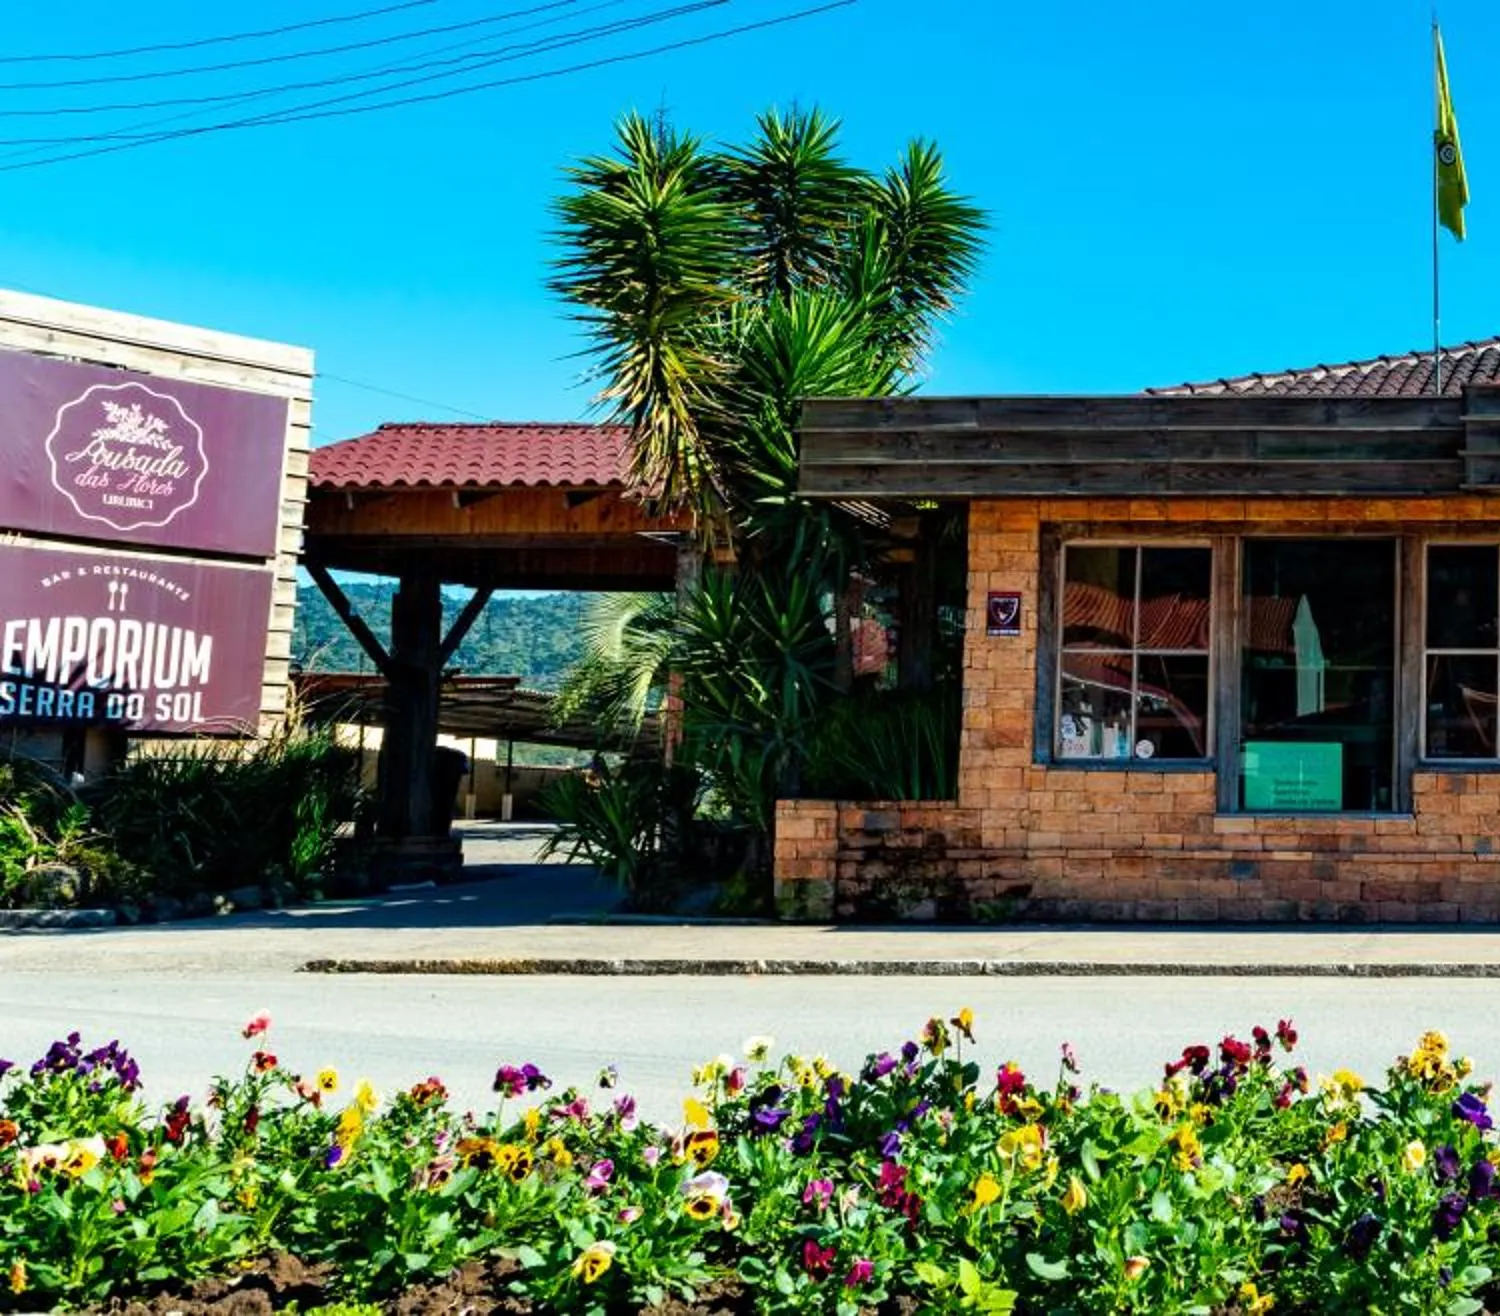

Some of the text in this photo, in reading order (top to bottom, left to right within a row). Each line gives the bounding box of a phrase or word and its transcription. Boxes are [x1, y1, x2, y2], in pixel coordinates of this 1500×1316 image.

[64, 436, 190, 478] Pousada
[74, 463, 176, 496] das Flores
[41, 570, 71, 588] BAR
[93, 564, 190, 601] RESTAURANTE
[1, 615, 214, 690] EMPORIUM
[0, 681, 206, 724] SERRA DO SOL
